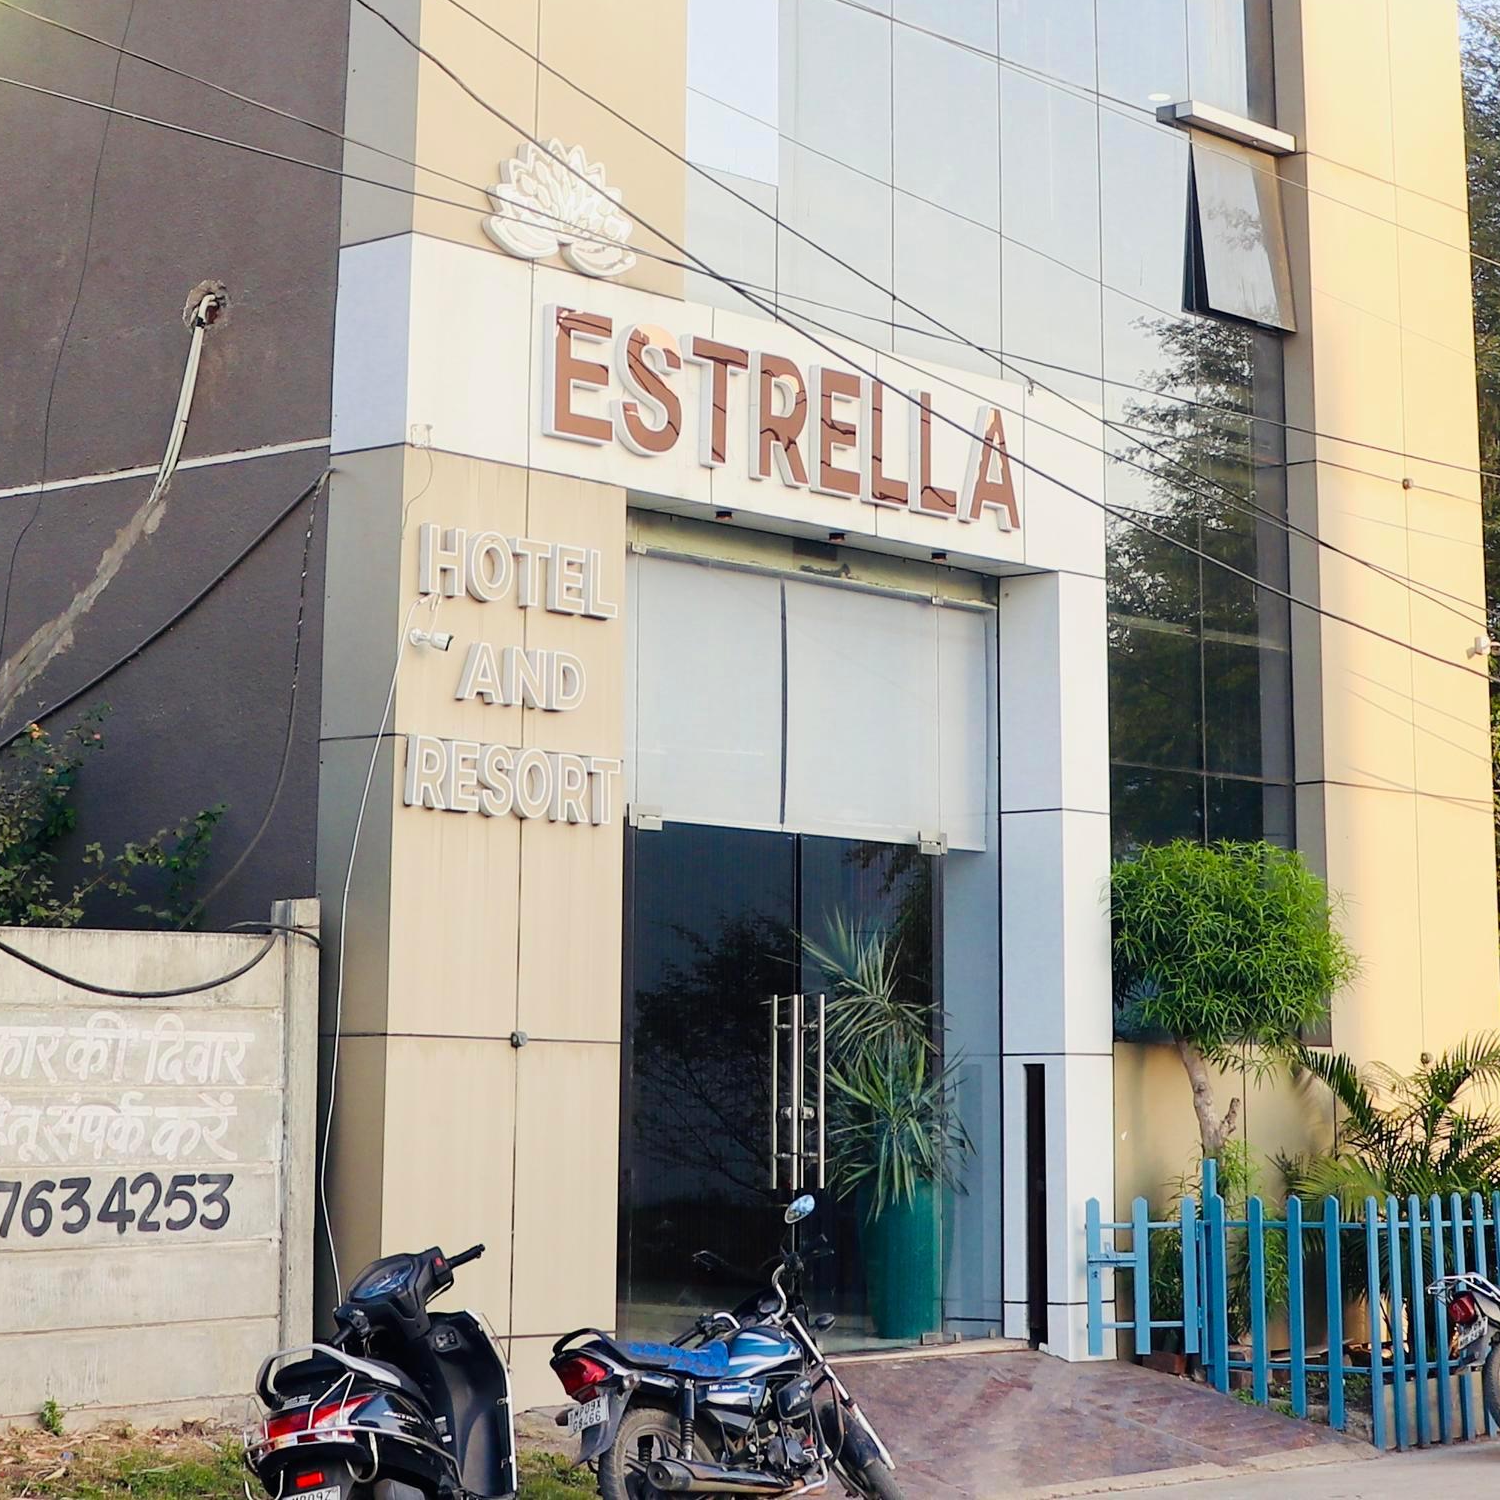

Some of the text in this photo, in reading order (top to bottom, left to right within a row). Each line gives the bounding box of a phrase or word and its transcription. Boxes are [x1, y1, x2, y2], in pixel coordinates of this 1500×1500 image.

[543, 304, 1023, 532] ESTRELLA
[419, 523, 618, 619] HOTEL
[455, 642, 587, 712] AND
[404, 734, 621, 825] RESORT
[66, 1011, 139, 1083] की
[43, 1092, 153, 1162] संपर्क
[150, 1092, 238, 1161] करें
